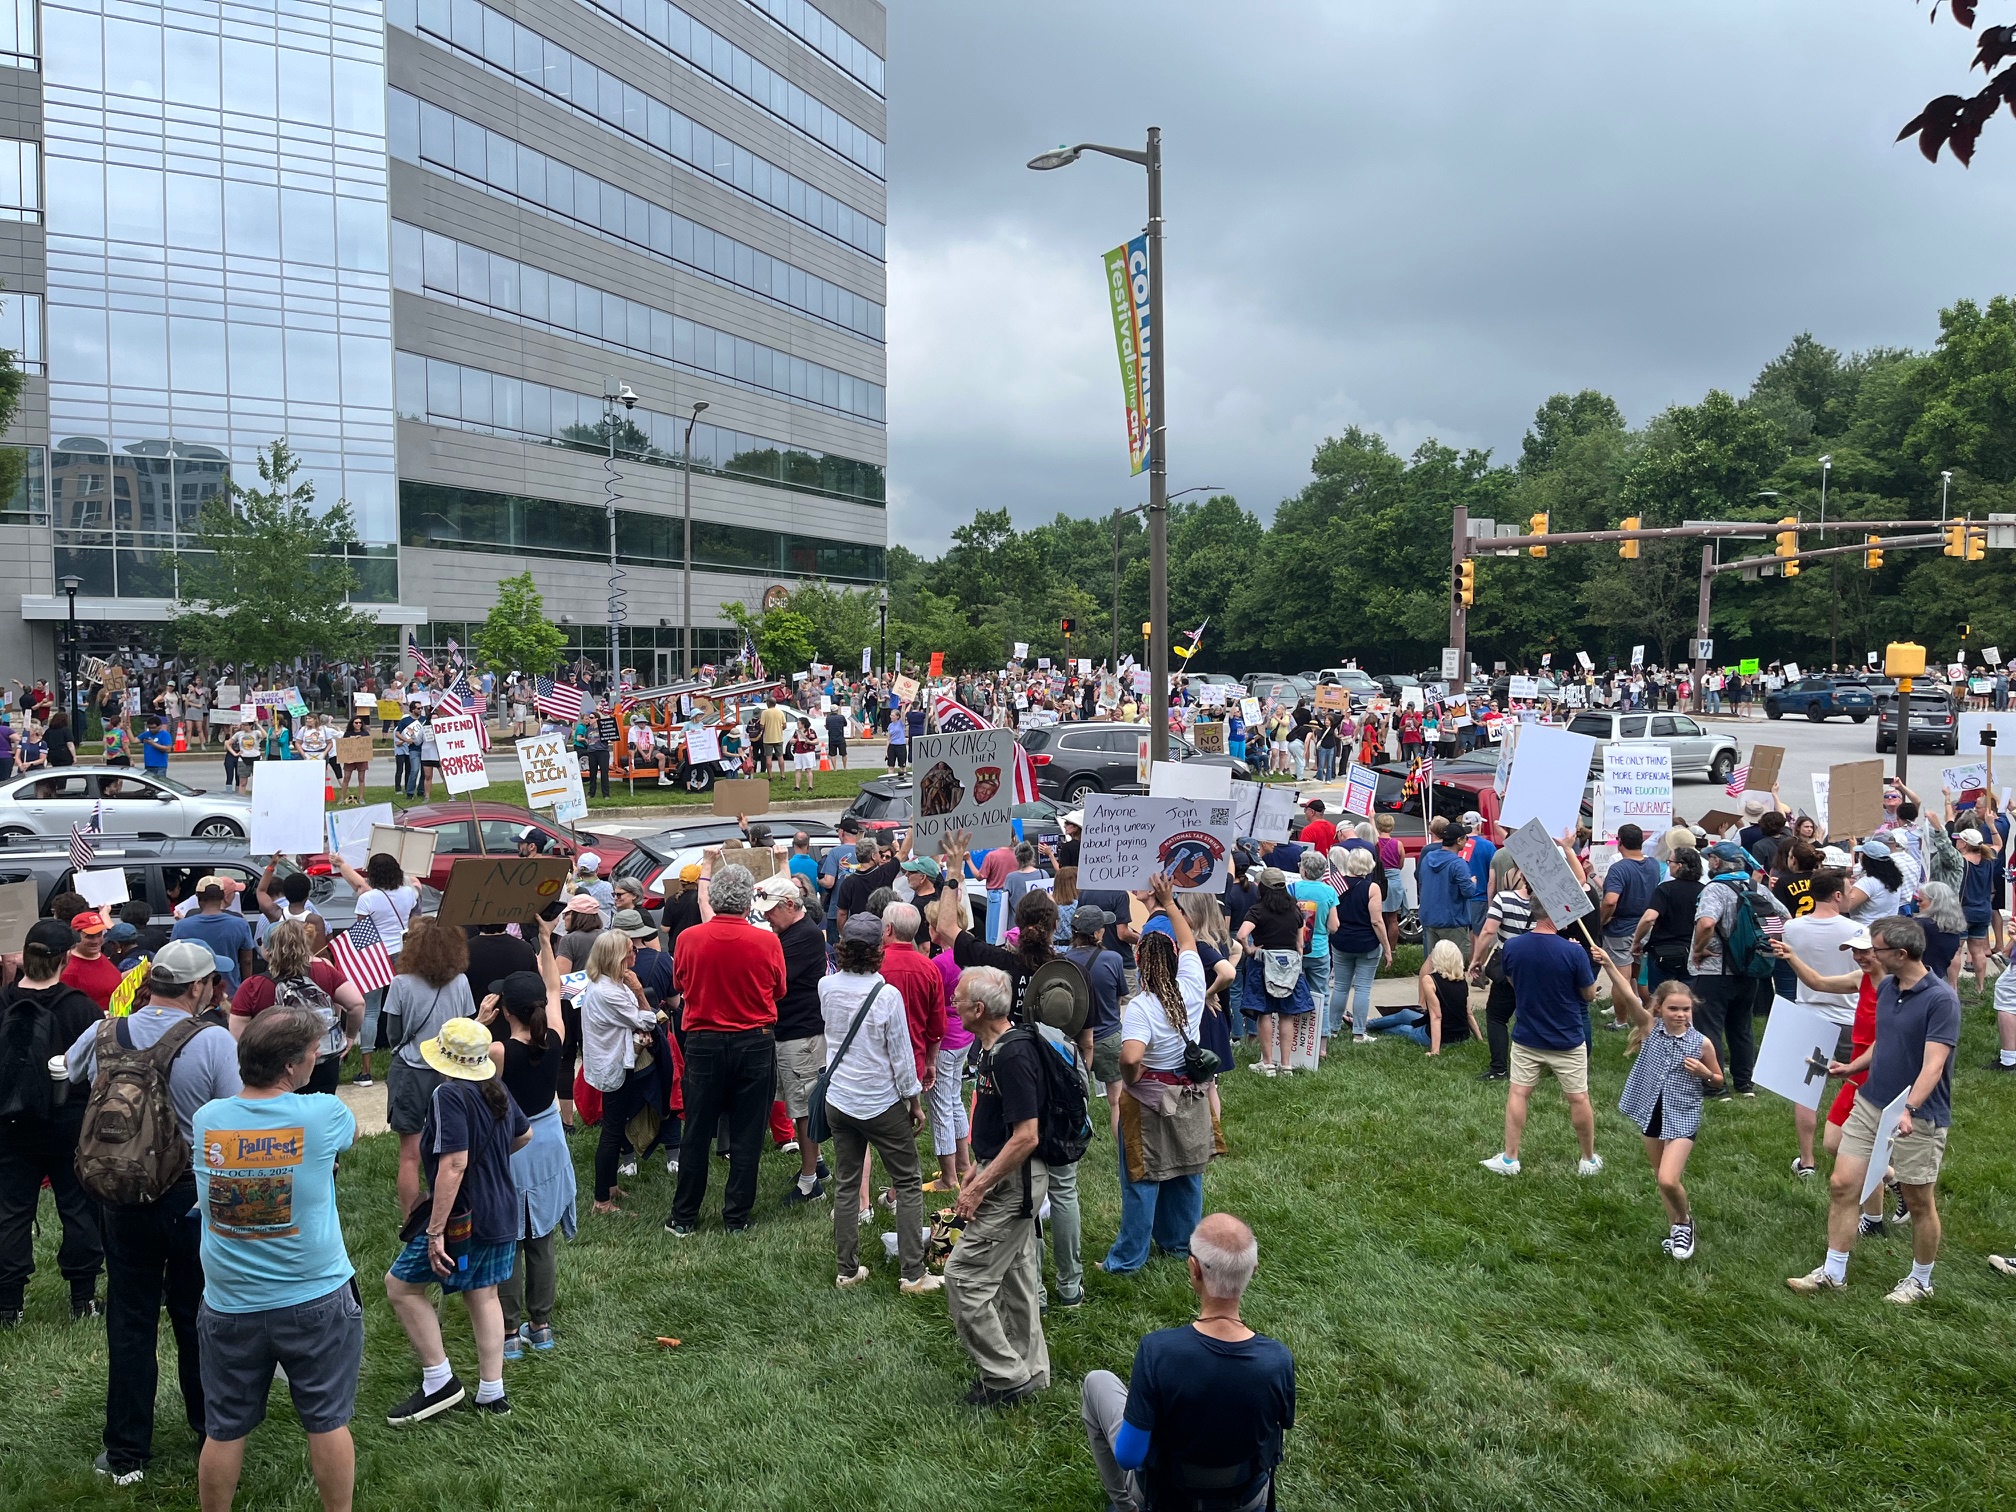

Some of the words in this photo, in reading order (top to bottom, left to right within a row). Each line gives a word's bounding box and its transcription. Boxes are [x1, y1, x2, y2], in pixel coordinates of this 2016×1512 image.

[1110, 258, 1138, 366] festival
[1126, 364, 1138, 382] of
[1128, 382, 1138, 409] the
[1130, 409, 1142, 464] arts
[1429, 686, 1438, 695] NO
[434, 719, 474, 735] DEFEND
[446, 739, 465, 750] THE
[918, 737, 942, 760] NO
[949, 731, 998, 757] KINGS
[1200, 735, 1220, 746] NO
[521, 742, 559, 760] TAX
[971, 752, 996, 764] THEN
[530, 758, 556, 770] THE
[1608, 756, 1625, 766] THE
[1625, 756, 1646, 766] ONLY
[1646, 756, 1669, 766] THING
[524, 766, 568, 785] RICH
[1612, 771, 1633, 781] MORE
[1636, 771, 1671, 781] EXPENSIVE
[1613, 786, 1632, 795] THAN
[1635, 786, 1670, 796] EDUCATION
[1093, 804, 1138, 821] Anyone
[1165, 806, 1198, 820] Join
[1613, 805, 1621, 813] IS
[1624, 801, 1672, 815] IGNORANCE
[916, 820, 939, 838] NO
[943, 813, 979, 832] KINGS
[1084, 822, 1121, 836] feeling
[1124, 821, 1156, 834] uneasy
[1181, 817, 1202, 829] the
[1083, 837, 1113, 850] about
[1116, 836, 1148, 852] paying
[1164, 833, 1192, 847] NATIONAL
[1193, 832, 1203, 840] TAX
[1203, 836, 1221, 850] STRIKE
[1084, 853, 1112, 865] taxes
[1117, 851, 1129, 863] to
[1131, 853, 1139, 861] a
[485, 861, 538, 886] NO
[1089, 865, 1139, 883] COUP?
[1299, 1032, 1307, 1047] NOT
[1306, 1011, 1316, 1056] PRESIDENT
[237, 1136, 298, 1160] FallFest
[228, 1169, 255, 1178] OCT.
